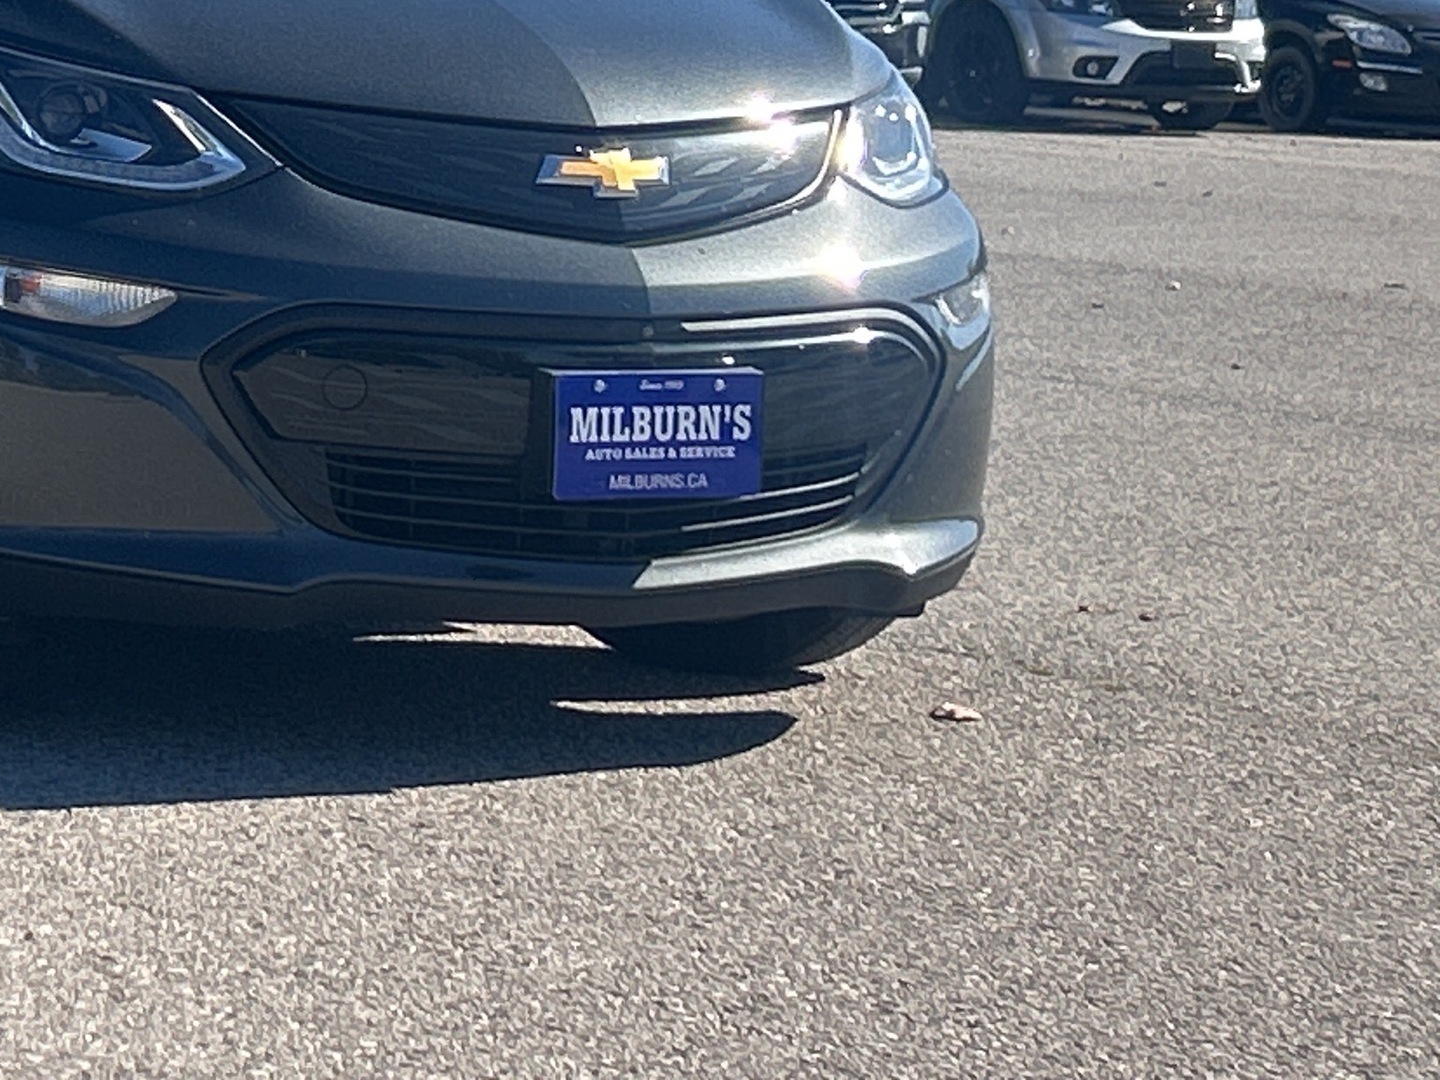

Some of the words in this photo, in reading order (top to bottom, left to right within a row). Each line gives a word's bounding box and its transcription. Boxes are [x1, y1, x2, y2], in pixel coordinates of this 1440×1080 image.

[569, 403, 752, 444] MILBURN'S
[585, 448, 623, 461] AUTO
[624, 447, 666, 460] SALES
[667, 447, 678, 459] &
[679, 445, 736, 459] SERVICE
[609, 473, 709, 490] MILBURNS.CA
